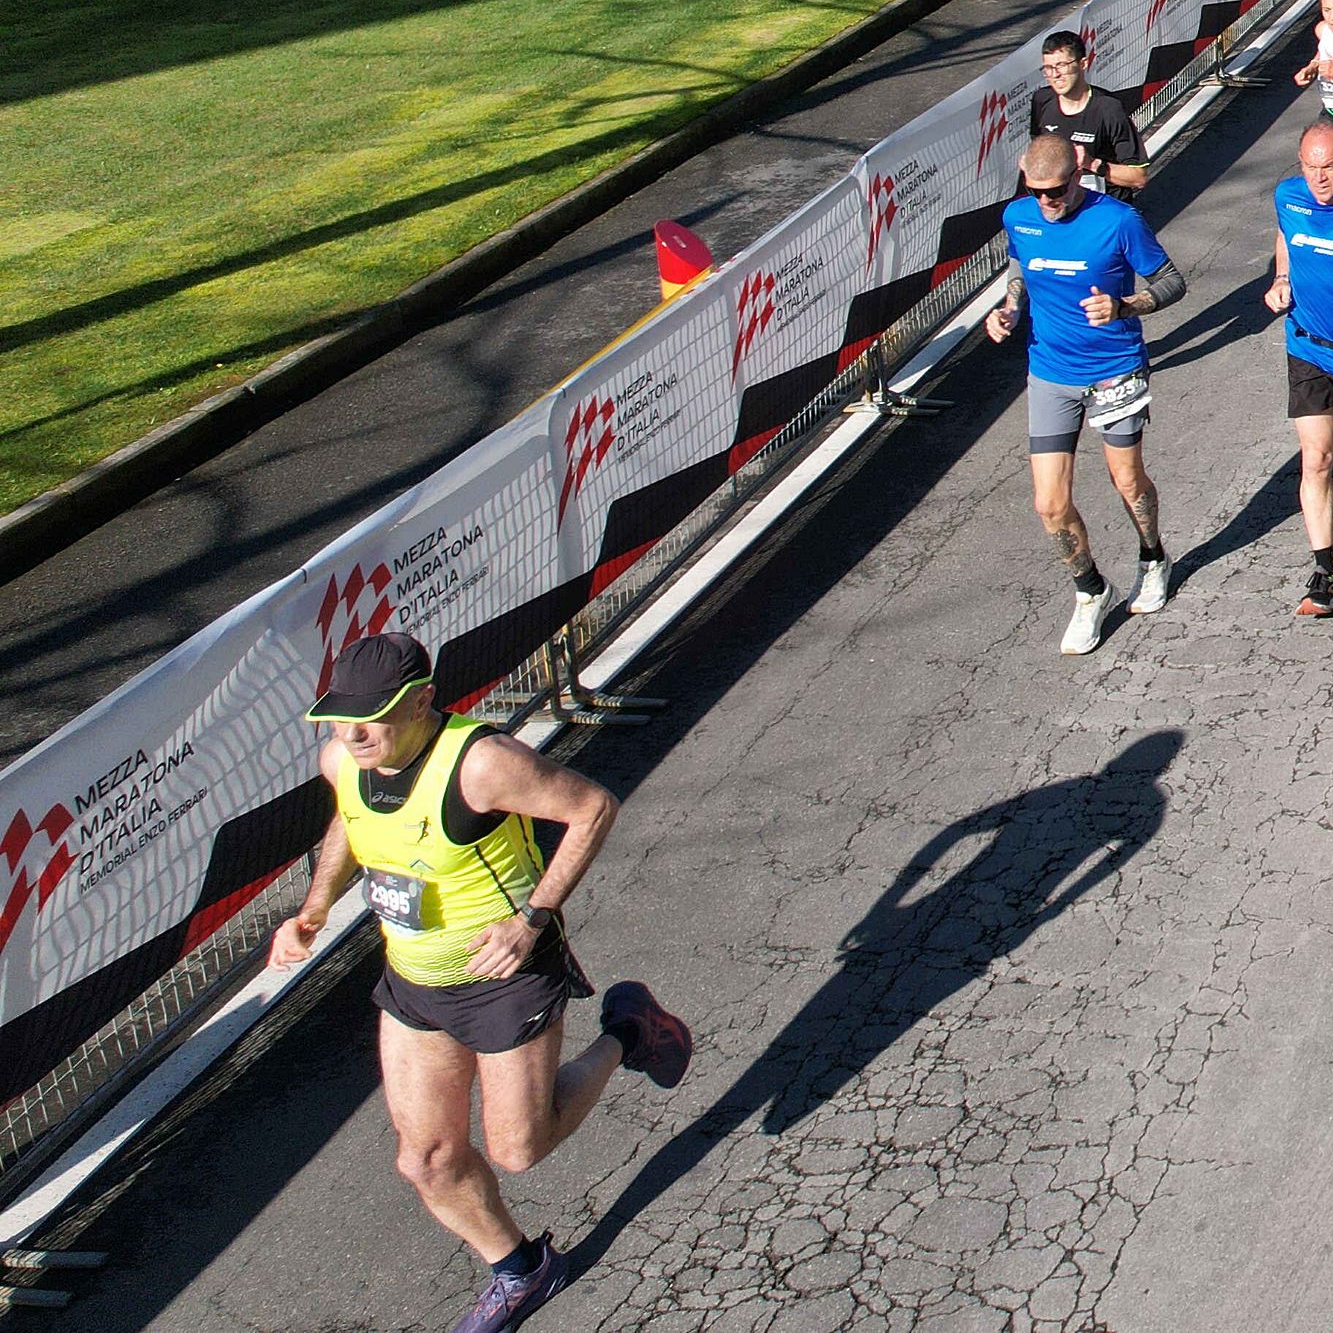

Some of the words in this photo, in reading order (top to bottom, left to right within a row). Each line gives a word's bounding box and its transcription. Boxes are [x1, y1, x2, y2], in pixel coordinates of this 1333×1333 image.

[897, 163, 938, 203] MARATONA
[775, 256, 823, 303] MARATONA
[616, 371, 653, 409] MEZZA
[617, 373, 678, 430] MARATONA
[393, 526, 447, 574] MEZZA
[397, 525, 484, 600] MARATONA
[399, 569, 459, 625] D'ITALIA
[74, 748, 149, 815] MEZZA
[80, 741, 195, 845] MARATONA
[382, 795, 407, 804] asic
[80, 798, 163, 875] D'ITALIA
[80, 845, 137, 895] MEMORIAL
[138, 819, 167, 848] ENZO
[168, 786, 208, 825] FERRARI
